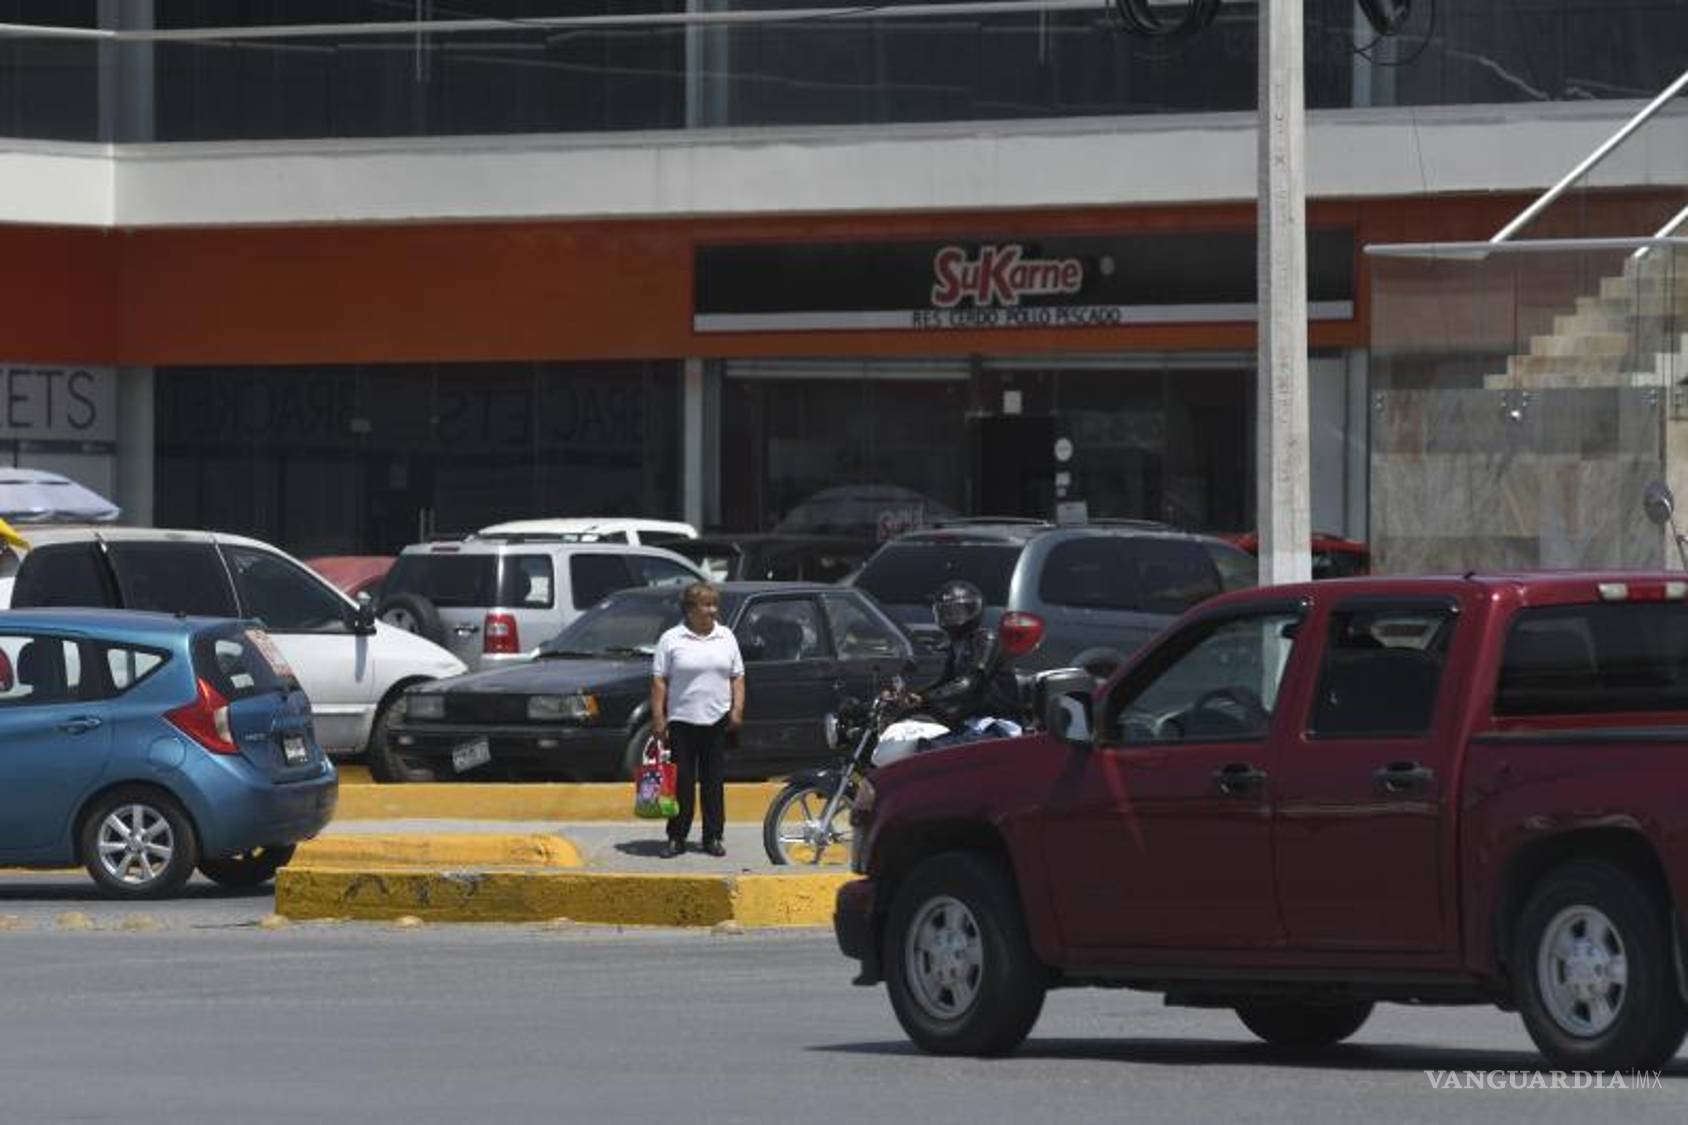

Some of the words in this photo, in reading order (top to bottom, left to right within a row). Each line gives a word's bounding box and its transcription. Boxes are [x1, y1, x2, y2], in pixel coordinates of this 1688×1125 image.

[931, 245, 1084, 307] SuKarne
[1056, 307, 1121, 323] PESCADO
[0, 369, 96, 430] ETS
